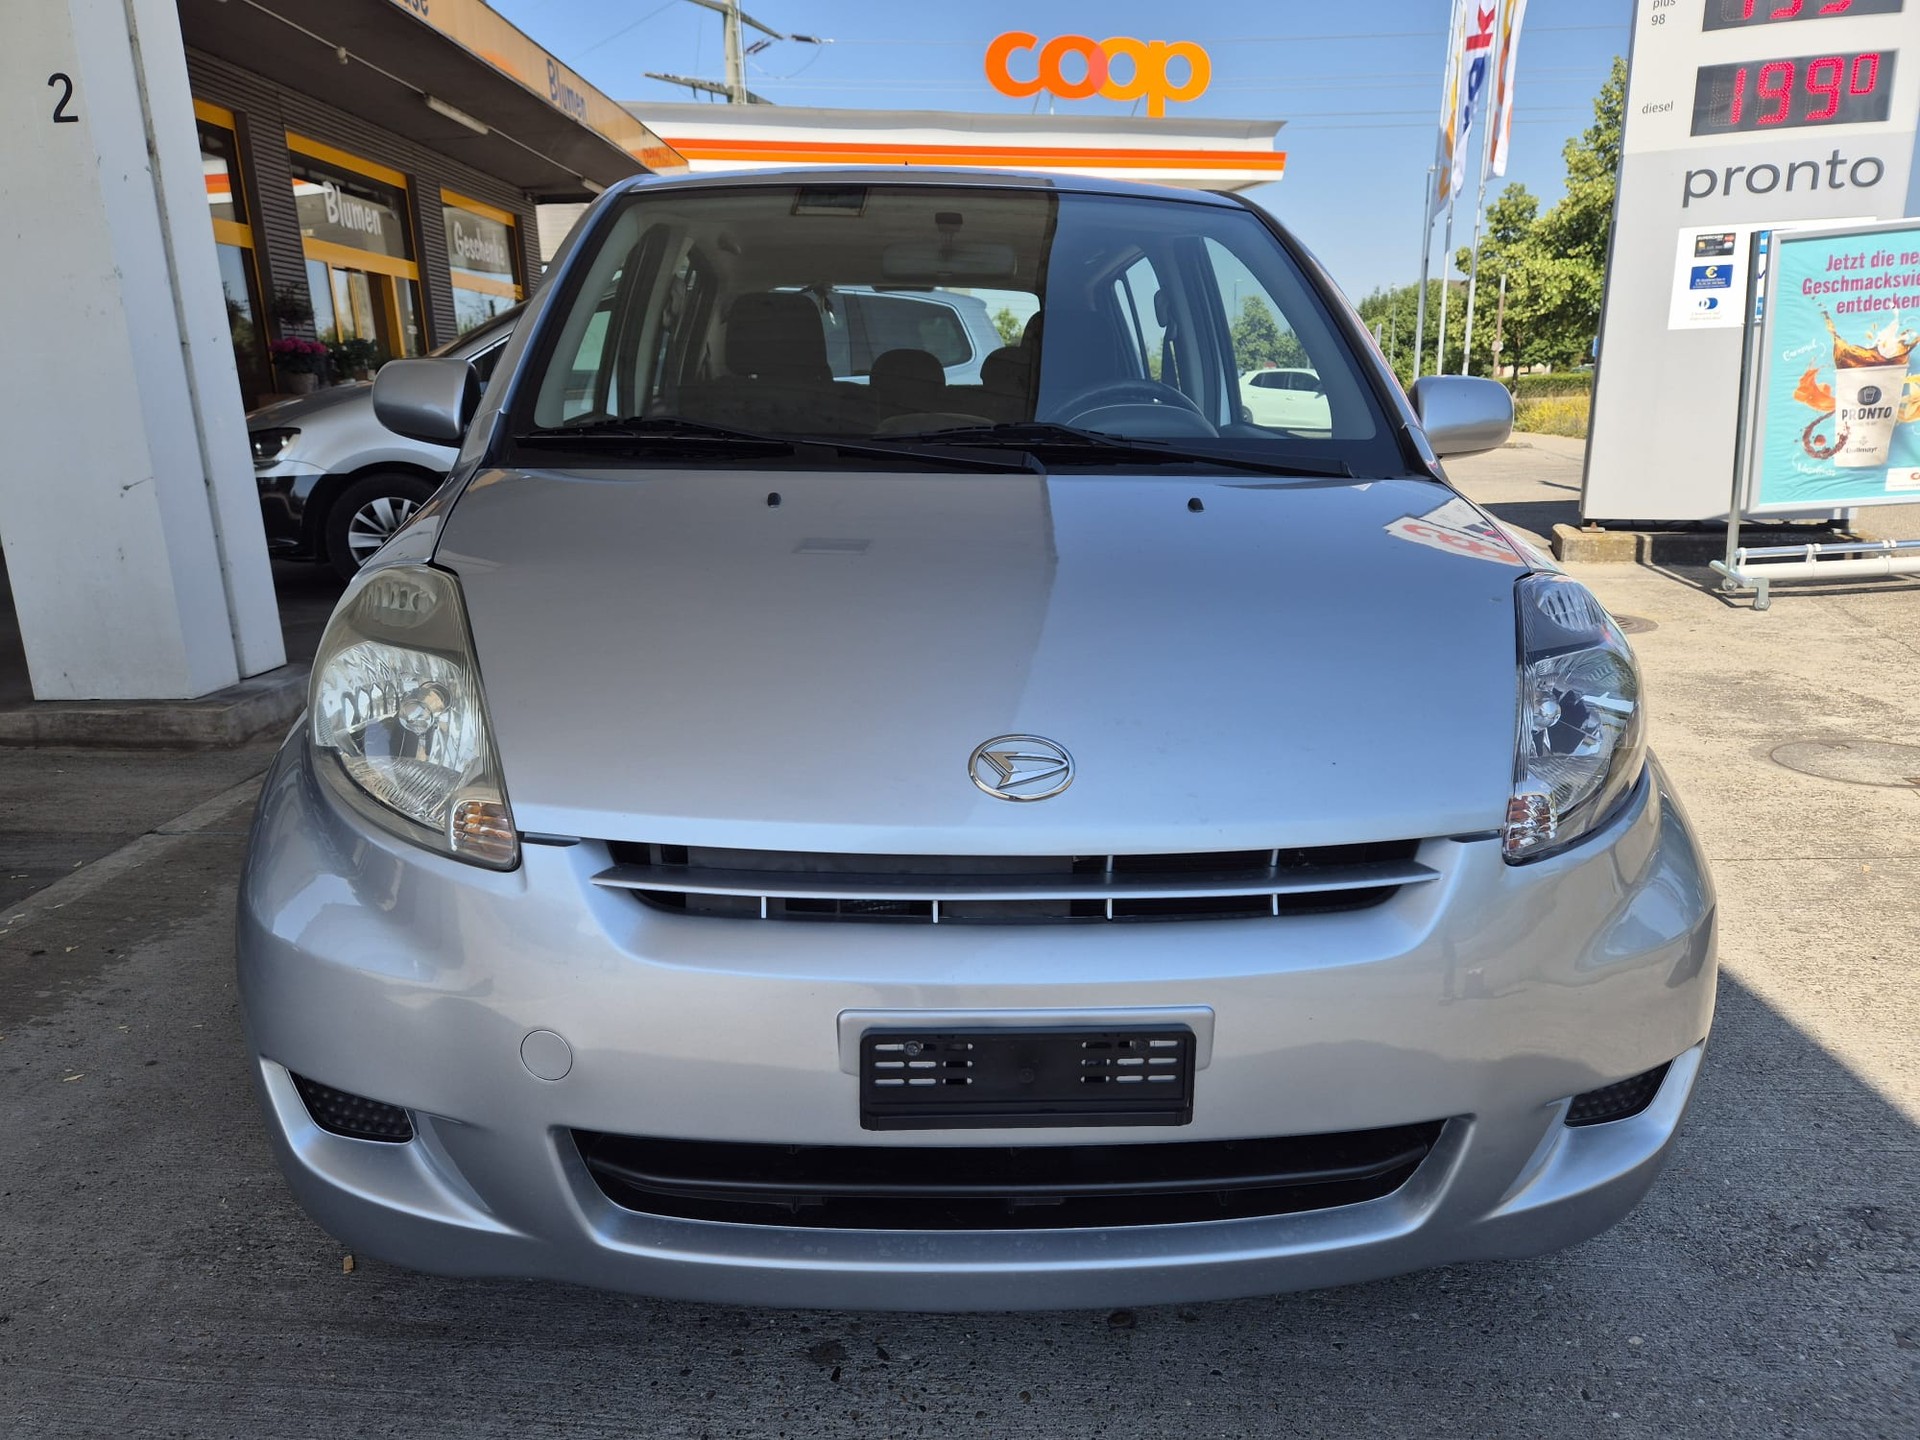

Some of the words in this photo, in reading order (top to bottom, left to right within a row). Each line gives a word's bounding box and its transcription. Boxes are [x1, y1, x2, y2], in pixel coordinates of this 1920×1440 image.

[1651, 13, 1666, 26] 98
[546, 58, 588, 122] Blumen
[983, 30, 1212, 118] coop
[47, 72, 79, 123] 2
[1641, 101, 1674, 114] diesel
[1682, 149, 1885, 208] pronto
[322, 180, 382, 236] Blumen
[1825, 252, 1865, 272] Jetzt
[1871, 249, 1894, 268] die
[1900, 251, 1920, 266] ne
[1836, 293, 1920, 314] entdecken
[1841, 406, 1893, 421] PRONTO
